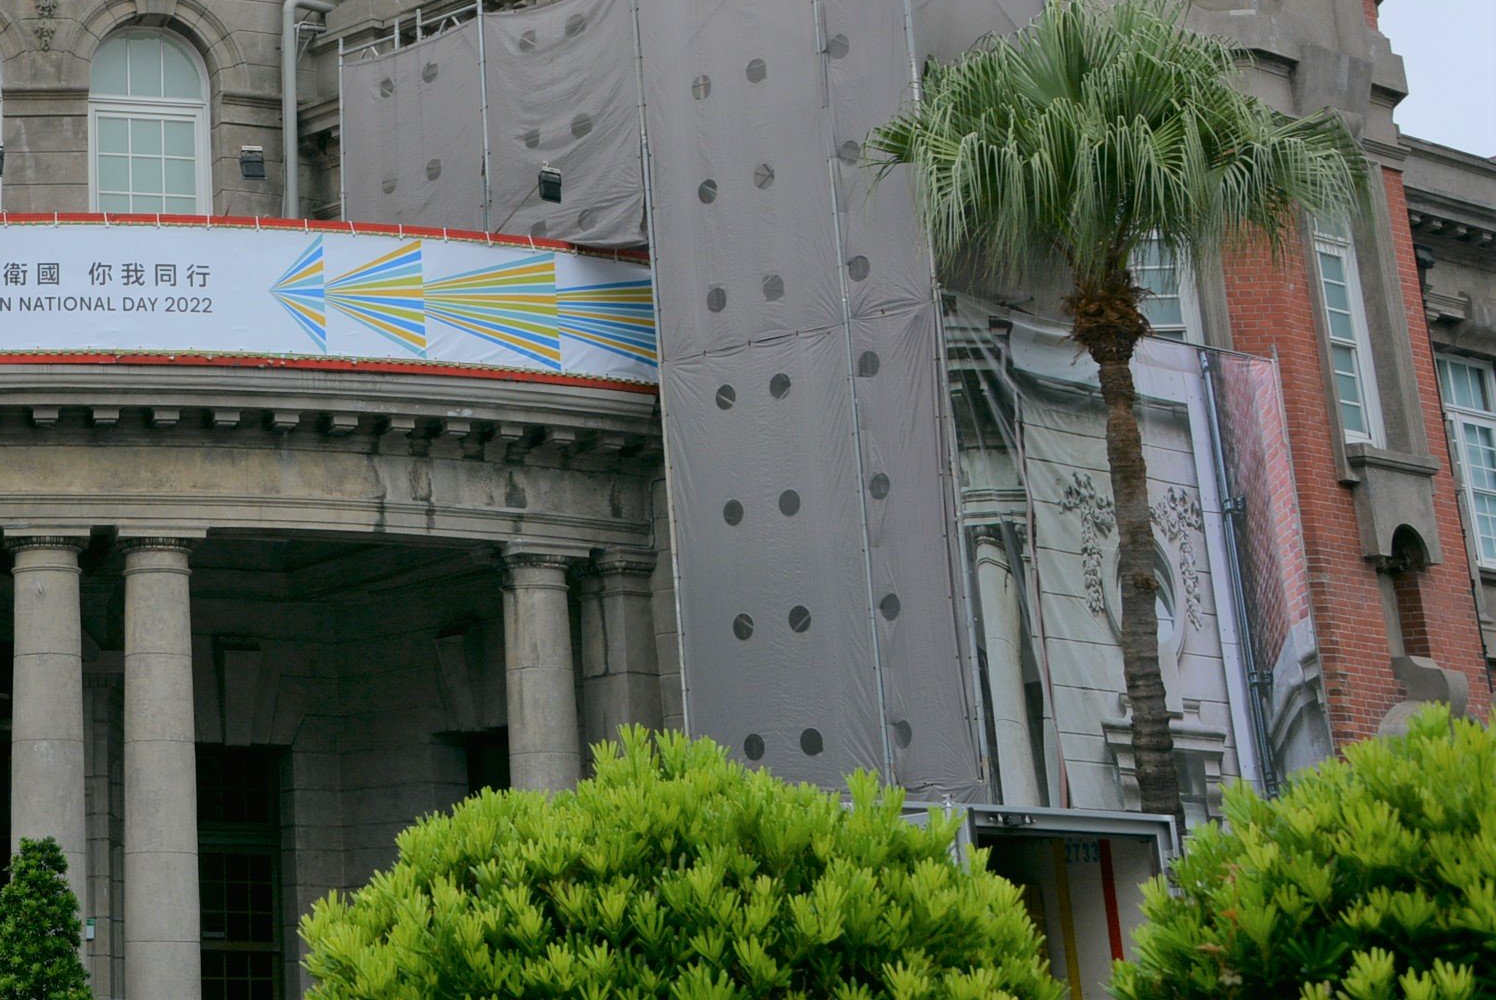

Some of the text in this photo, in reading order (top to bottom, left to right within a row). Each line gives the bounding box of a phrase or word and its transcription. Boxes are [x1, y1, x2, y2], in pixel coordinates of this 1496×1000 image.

[88, 262, 211, 288] 你我同行
[19, 296, 117, 312] NATIONAL
[122, 296, 159, 313] DAY
[164, 297, 213, 314] 2022
